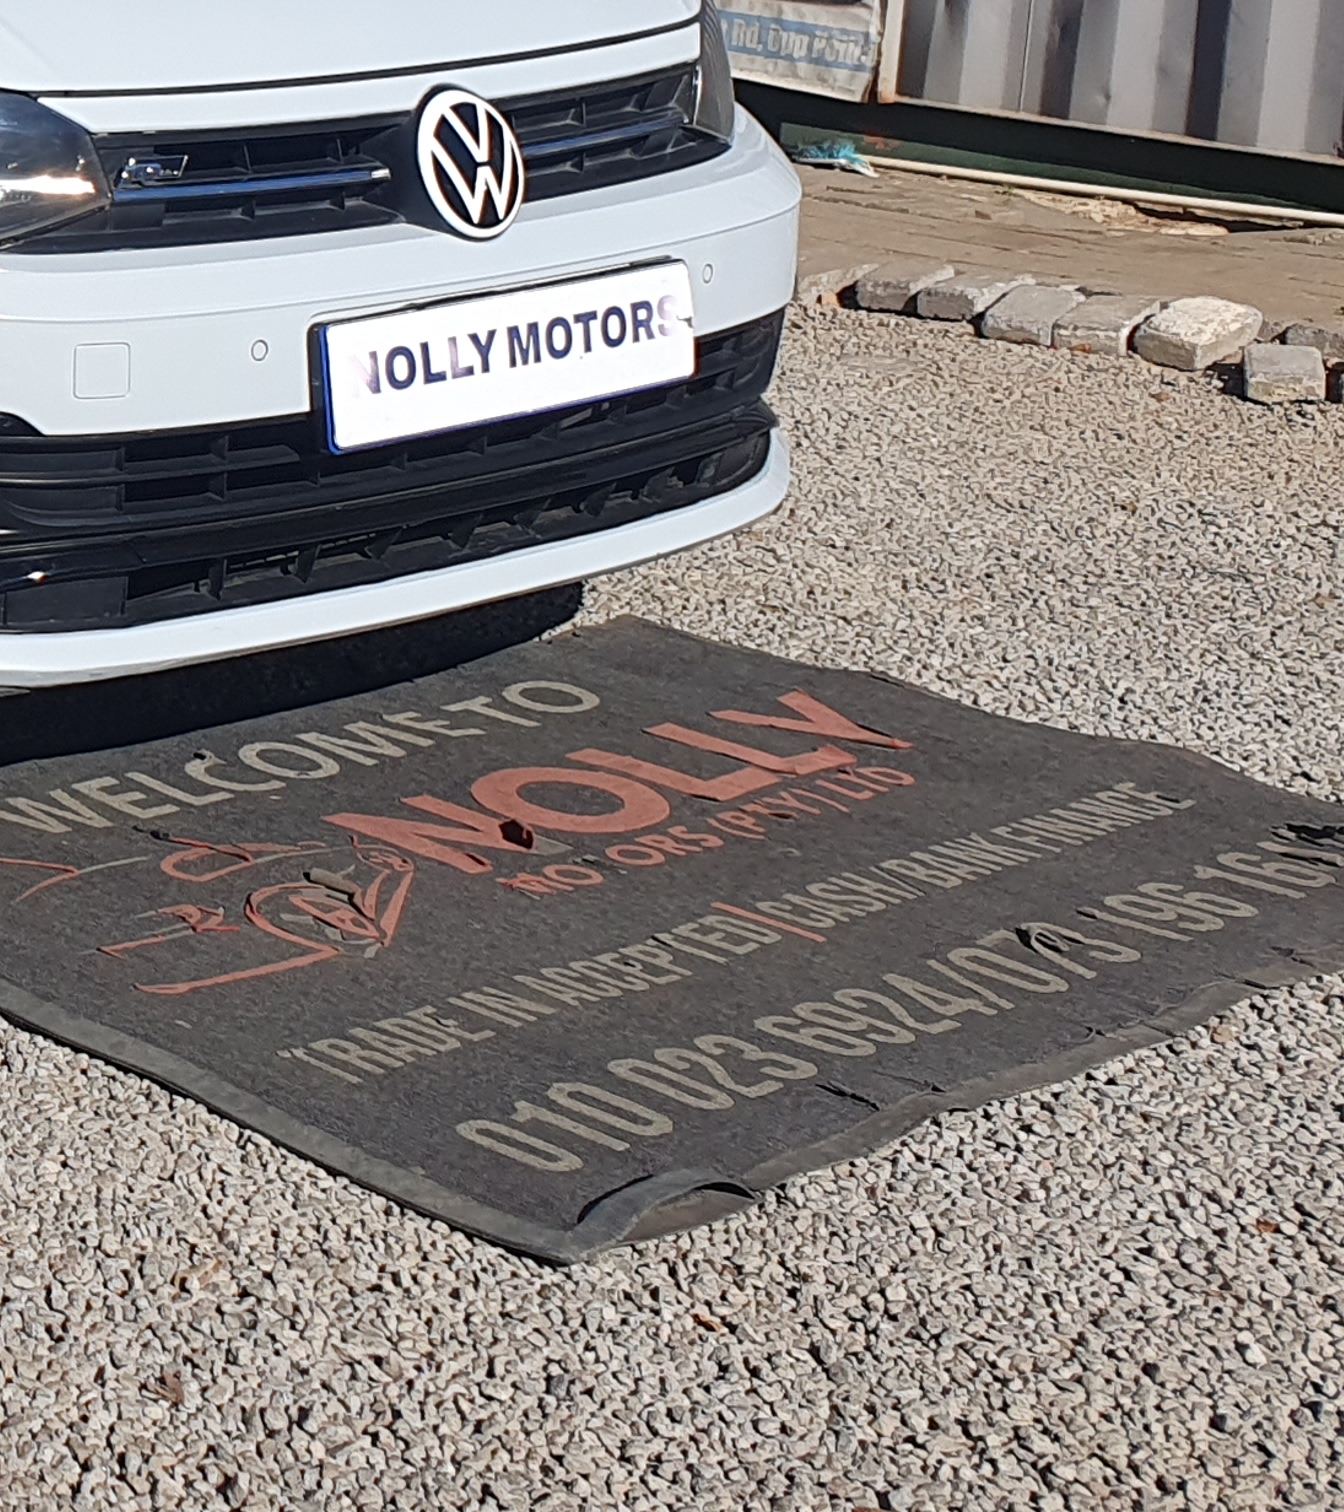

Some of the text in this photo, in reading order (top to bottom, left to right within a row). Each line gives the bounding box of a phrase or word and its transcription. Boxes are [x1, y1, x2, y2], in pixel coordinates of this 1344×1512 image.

[348, 294, 678, 396] NOLLY MOTORS
[320, 687, 913, 876] NOLLY
[441, 679, 602, 730] TO
[276, 1004, 497, 1085] TRADE
[446, 985, 558, 1029] IN
[992, 781, 1197, 860] FINANCE
[455, 1081, 674, 1173] 010
[608, 1033, 819, 1111] 023
[1076, 880, 1260, 942] 196
